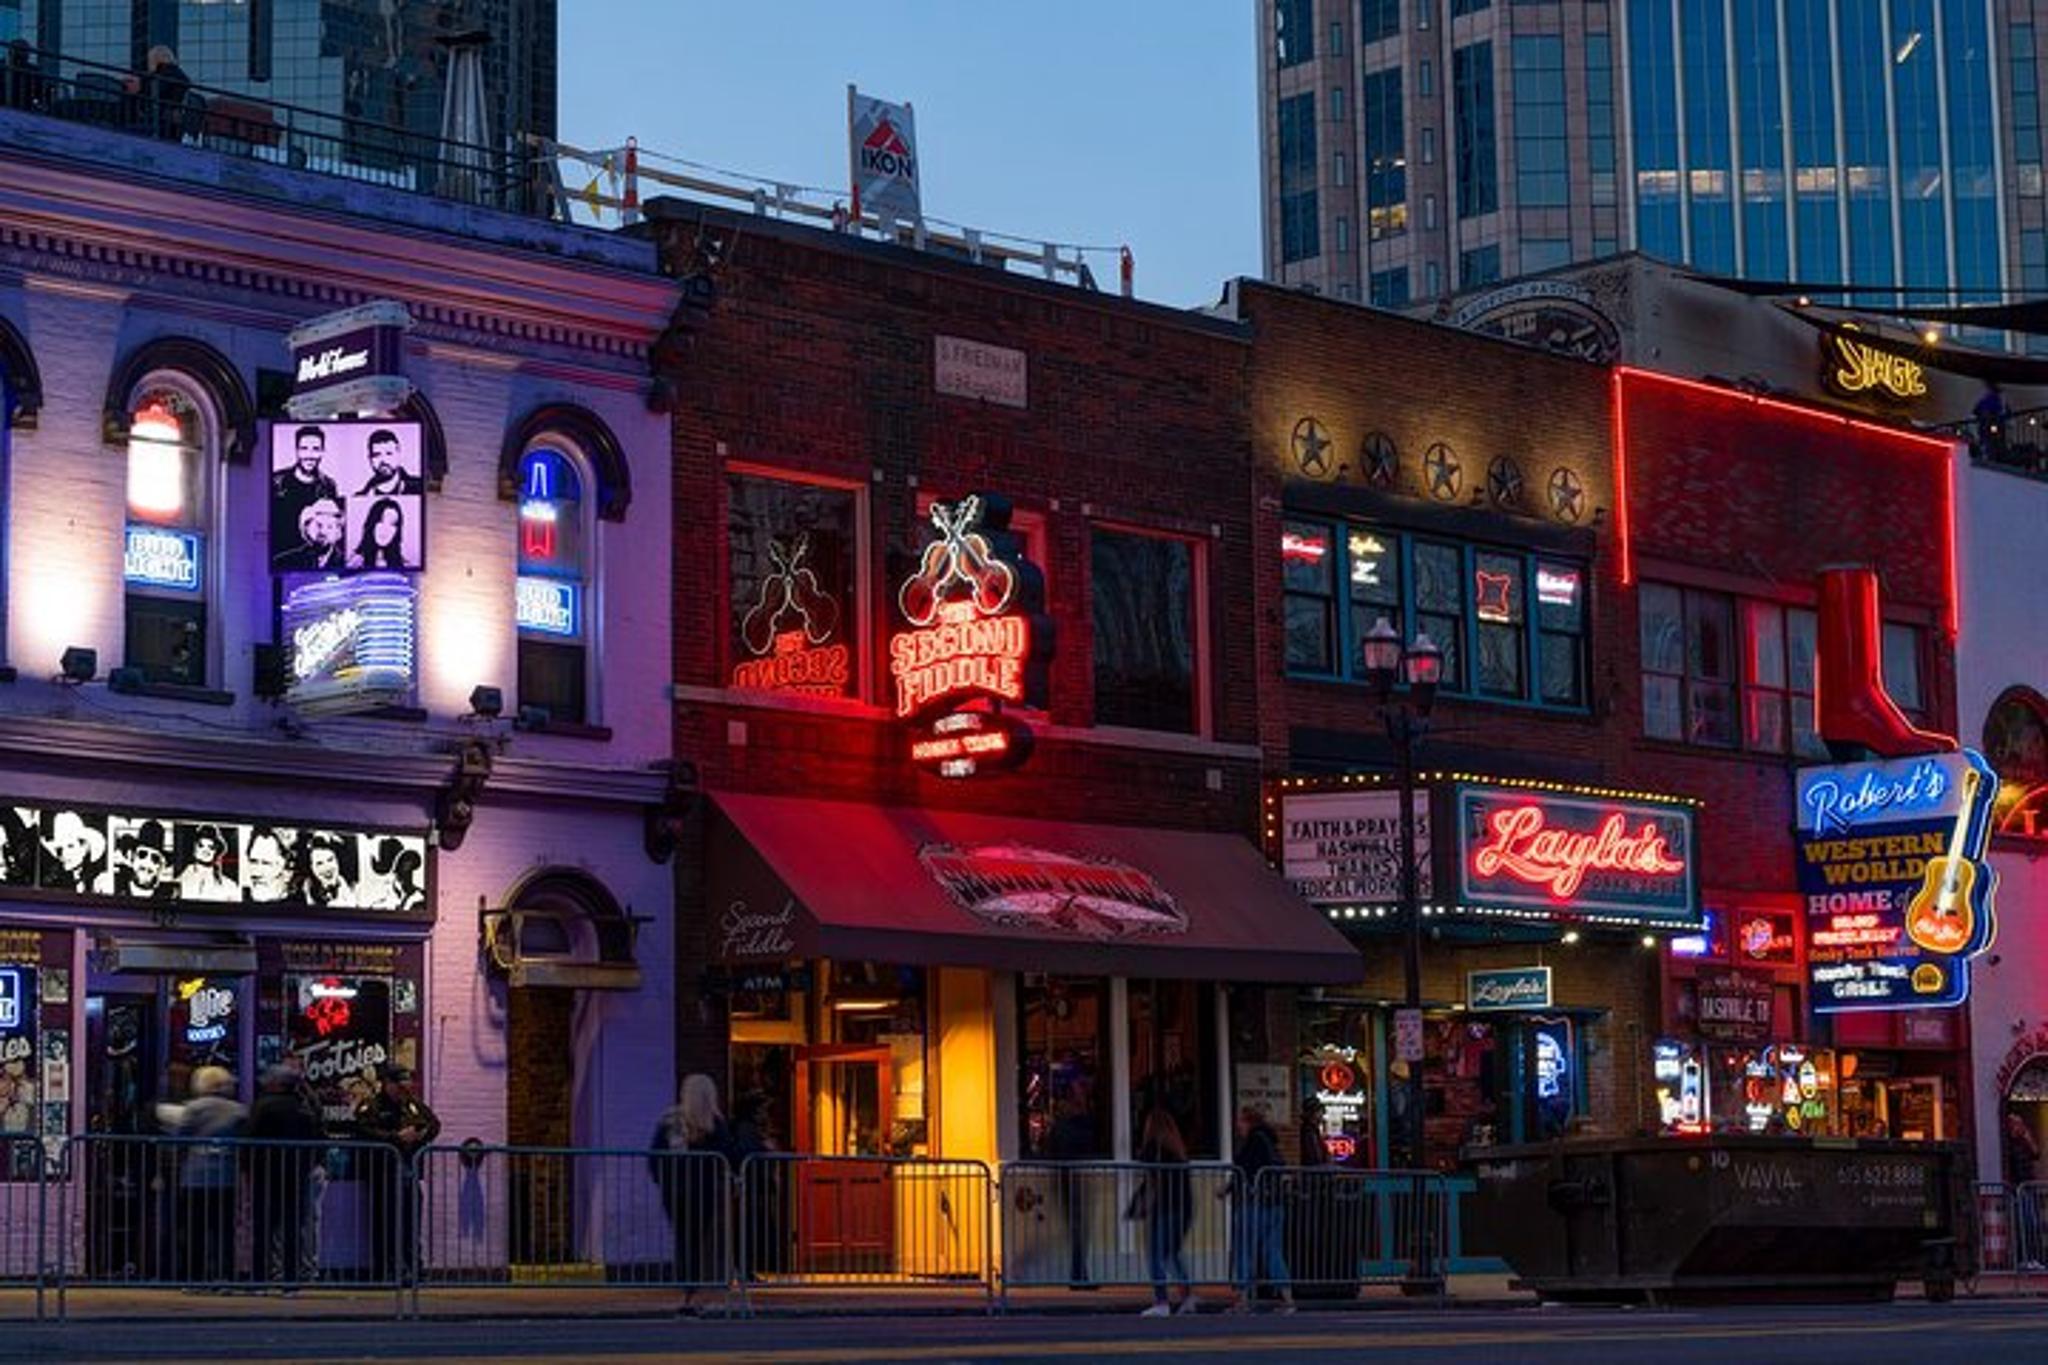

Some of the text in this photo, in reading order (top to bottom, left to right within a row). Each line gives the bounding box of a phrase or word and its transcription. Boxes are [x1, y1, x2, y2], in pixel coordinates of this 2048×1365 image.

[861, 148, 912, 177] IKON
[890, 616, 1024, 675] SECOND
[896, 655, 1020, 717] FIDDLE
[1806, 760, 1944, 836] Robert's
[1476, 806, 1685, 897] Layla's
[1804, 832, 1944, 863] WESTERN
[1823, 858, 1927, 885] WORLD
[720, 898, 795, 932] Second
[1808, 891, 1892, 914] HOME
[721, 927, 795, 958] Fiddle
[743, 977, 784, 991] ATM
[297, 1038, 387, 1081] Tootsies
